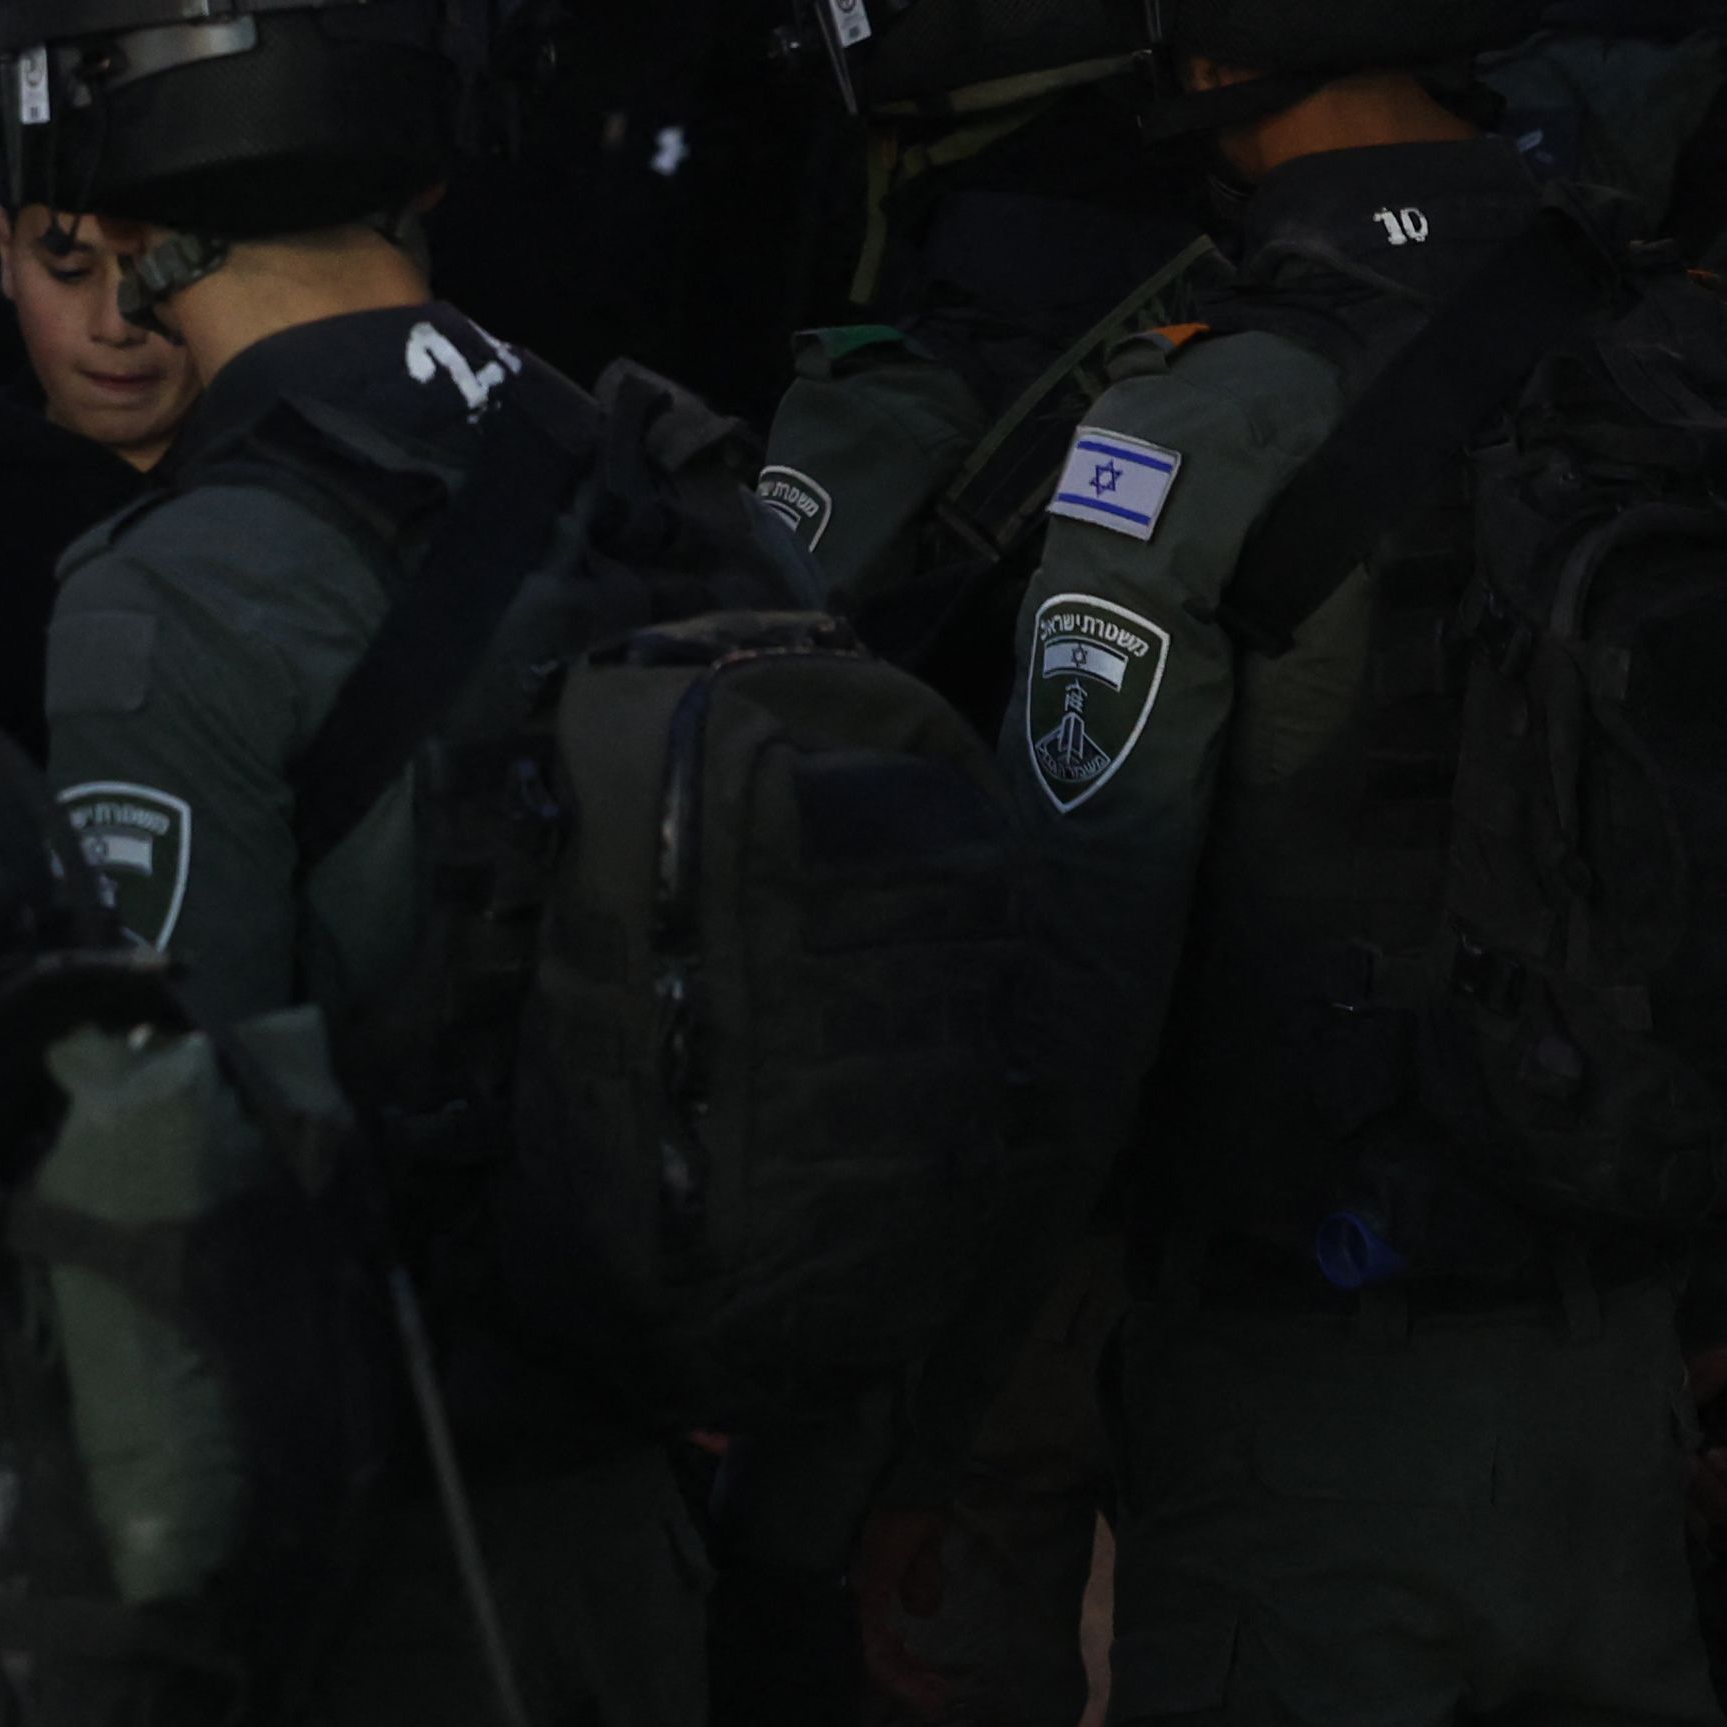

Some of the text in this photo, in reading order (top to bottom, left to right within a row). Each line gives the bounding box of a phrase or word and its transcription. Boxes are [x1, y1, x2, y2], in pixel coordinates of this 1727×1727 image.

[1372, 205, 1429, 246] 10
[1039, 612, 1150, 658] משטרת ישראל
